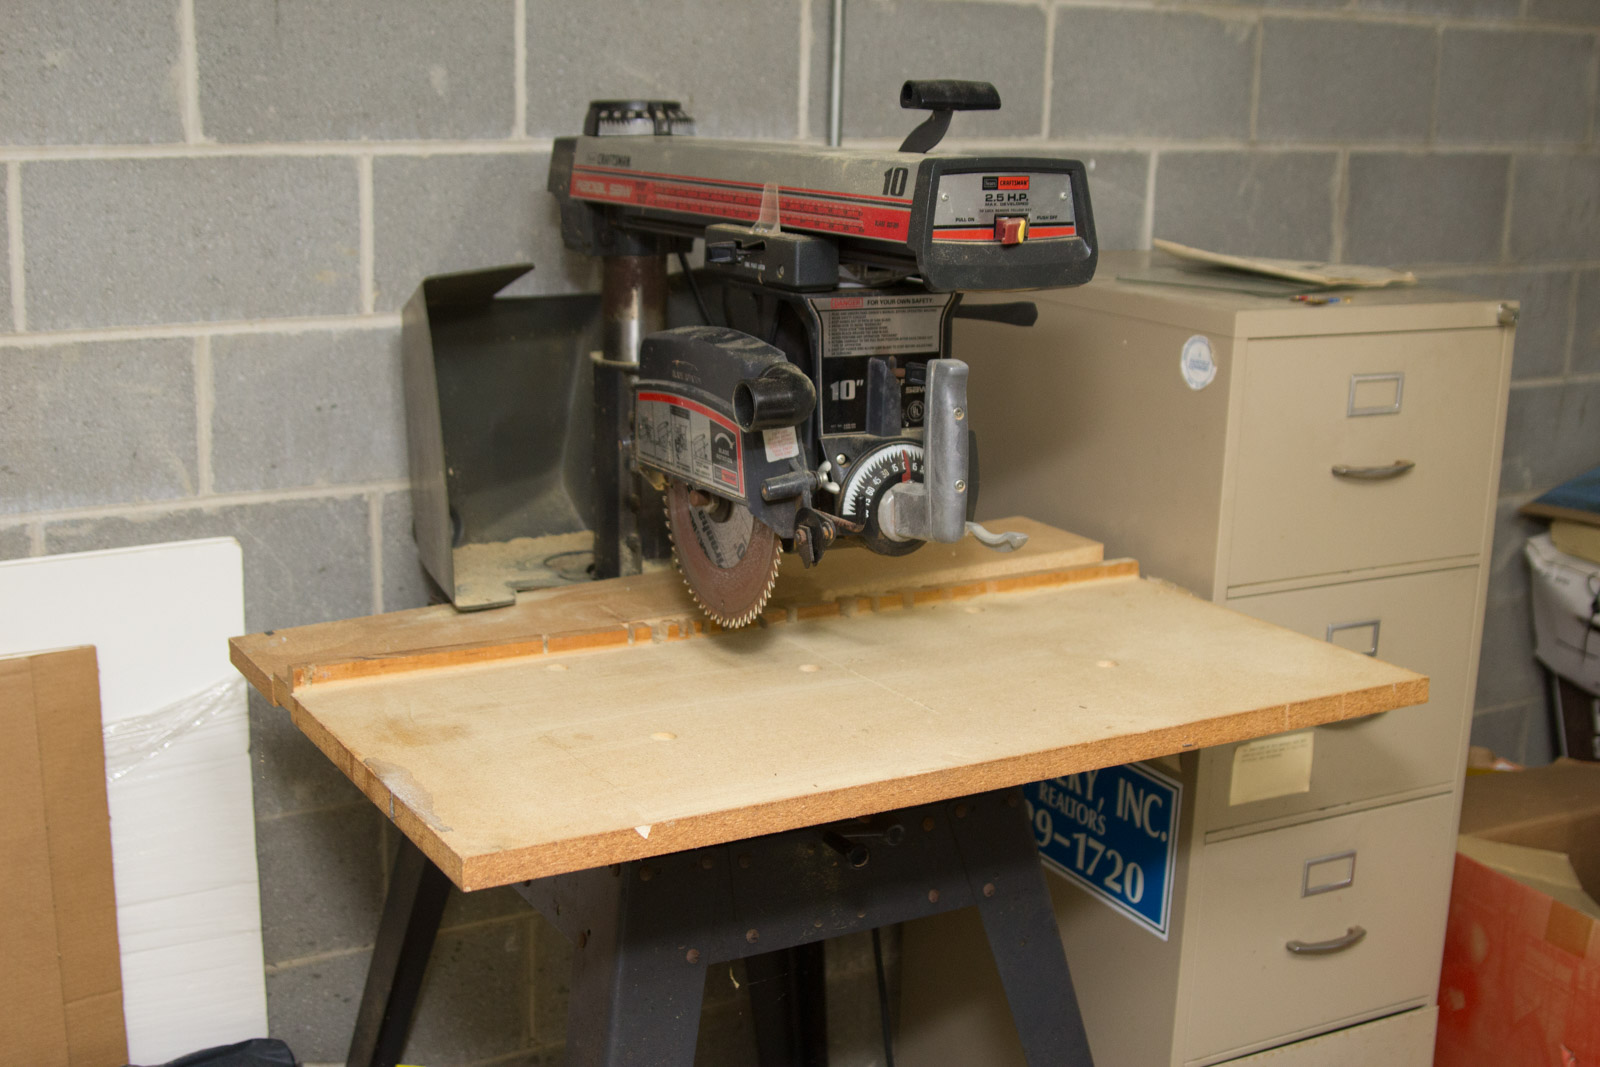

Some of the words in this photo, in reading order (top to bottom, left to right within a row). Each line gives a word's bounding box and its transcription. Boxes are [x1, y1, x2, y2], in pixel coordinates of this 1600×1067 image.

[882, 167, 909, 197] 10
[985, 193, 1004, 202] 2.5
[1007, 192, 1029, 202] H.P.
[830, 379, 864, 401] 10"
[873, 476, 882, 485] 45
[891, 463, 899, 472] 15
[912, 462, 918, 471] 15
[1038, 781, 1106, 836] REALTORS
[1116, 776, 1168, 842] INC.
